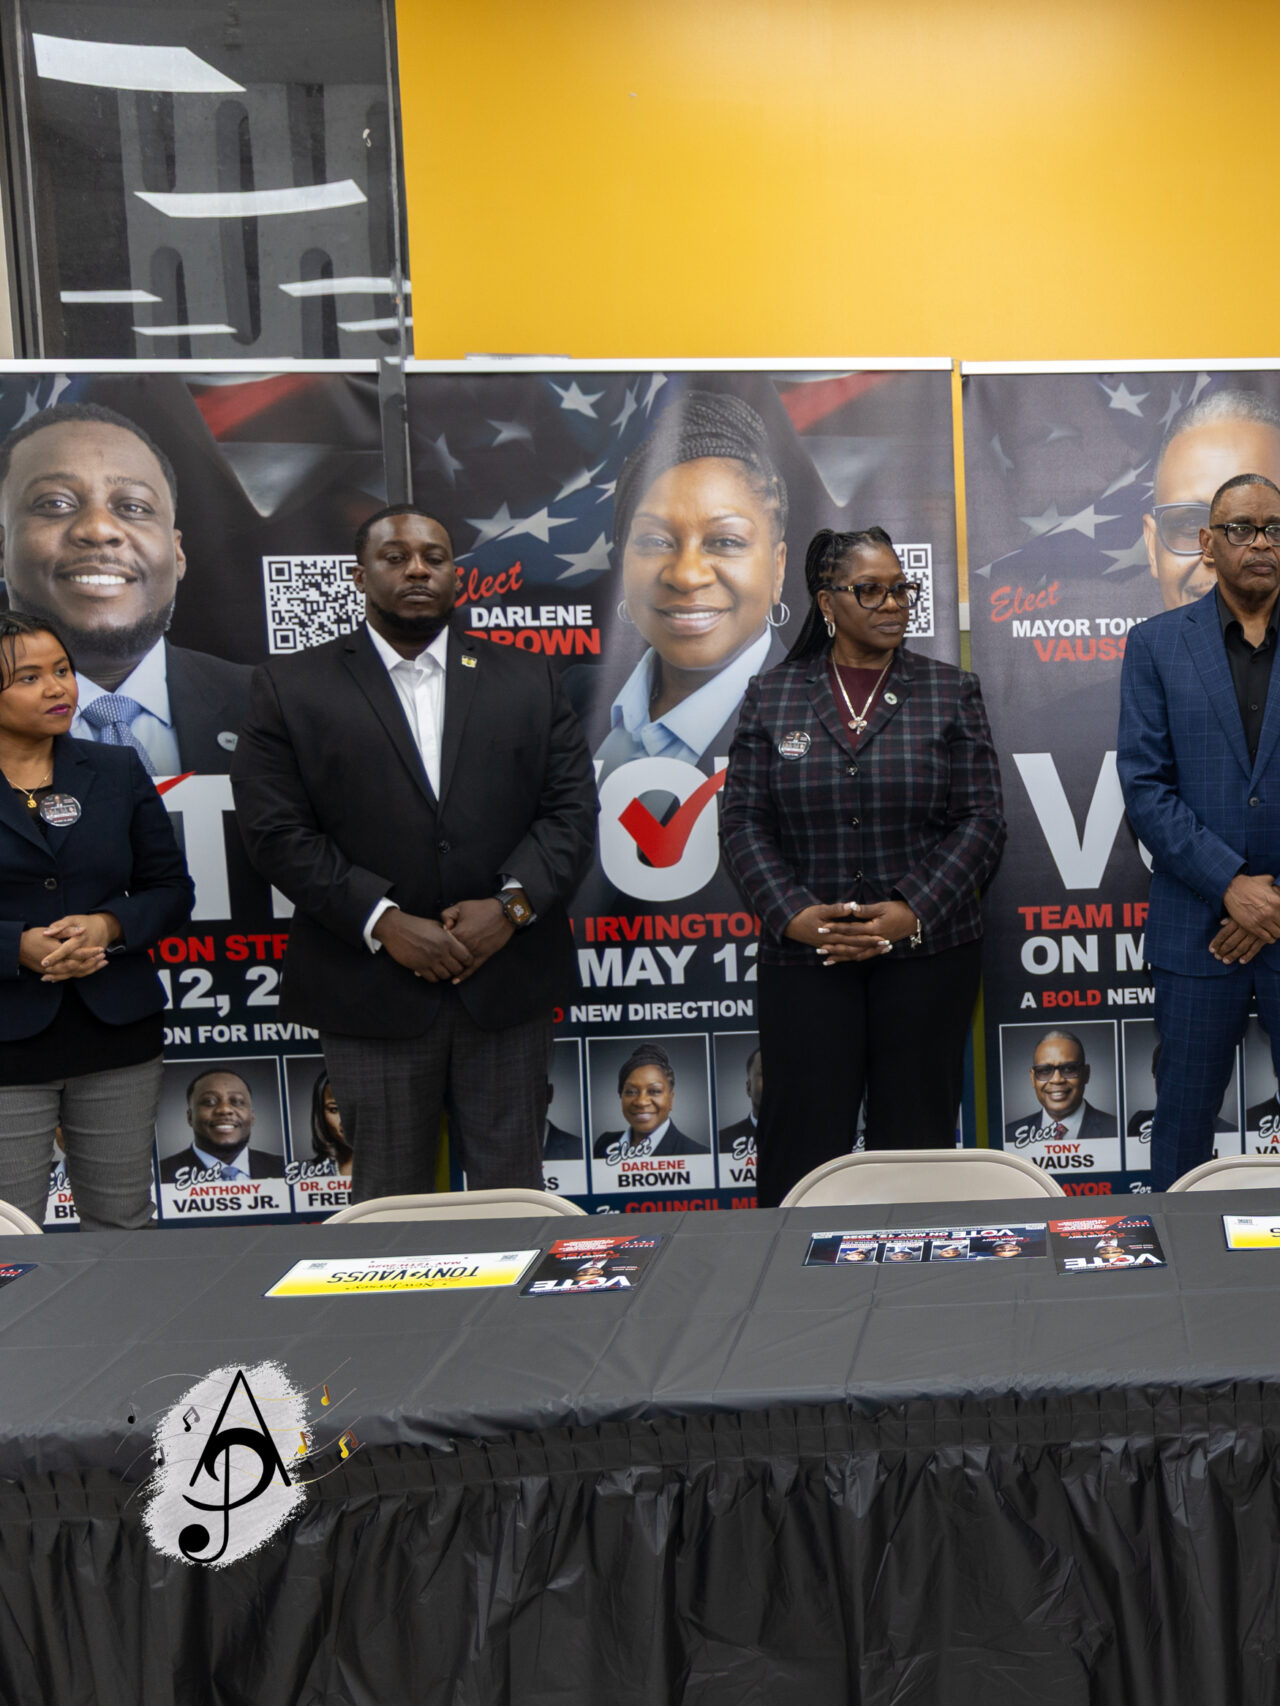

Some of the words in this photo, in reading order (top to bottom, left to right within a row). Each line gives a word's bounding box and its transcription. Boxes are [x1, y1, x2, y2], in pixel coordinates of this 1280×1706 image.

[989, 579, 1060, 623] Elect
[470, 605, 593, 628] DARLENE
[1012, 618, 1091, 638] MAYOR
[585, 912, 761, 942] IRVINGTO
[1018, 903, 1113, 931] TEAM
[225, 934, 290, 961] STR
[1020, 934, 1099, 975] ON
[577, 945, 698, 988] MAY
[1020, 991, 1037, 1009] A
[1042, 989, 1102, 1008] BOLD
[1107, 987, 1156, 1006] NEW
[570, 1004, 623, 1023] NEW
[628, 999, 753, 1021] DIRECTION
[198, 1024, 248, 1043] FOR
[253, 1022, 319, 1041] IRVIN
[1014, 1122, 1058, 1149] Elect
[605, 1135, 652, 1166] Elect
[1044, 1143, 1081, 1155] TONY
[285, 1158, 331, 1186] Elect
[621, 1160, 686, 1173] DARLENE
[1032, 1154, 1095, 1170] VAUSS
[175, 1161, 222, 1190] Elect
[617, 1171, 691, 1188] BROWN
[189, 1183, 262, 1197] ANTHONY
[300, 1181, 323, 1192] DR.
[1061, 1182, 1112, 1197] AYOR
[173, 1196, 242, 1213] VAUSS
[247, 1195, 279, 1209] JR.
[951, 1229, 1014, 1239] VOTE
[1064, 1253, 1162, 1269] VOTE
[326, 1269, 410, 1284] VAUSS
[419, 1265, 480, 1280] TONY
[529, 1275, 631, 1292] VOTE
